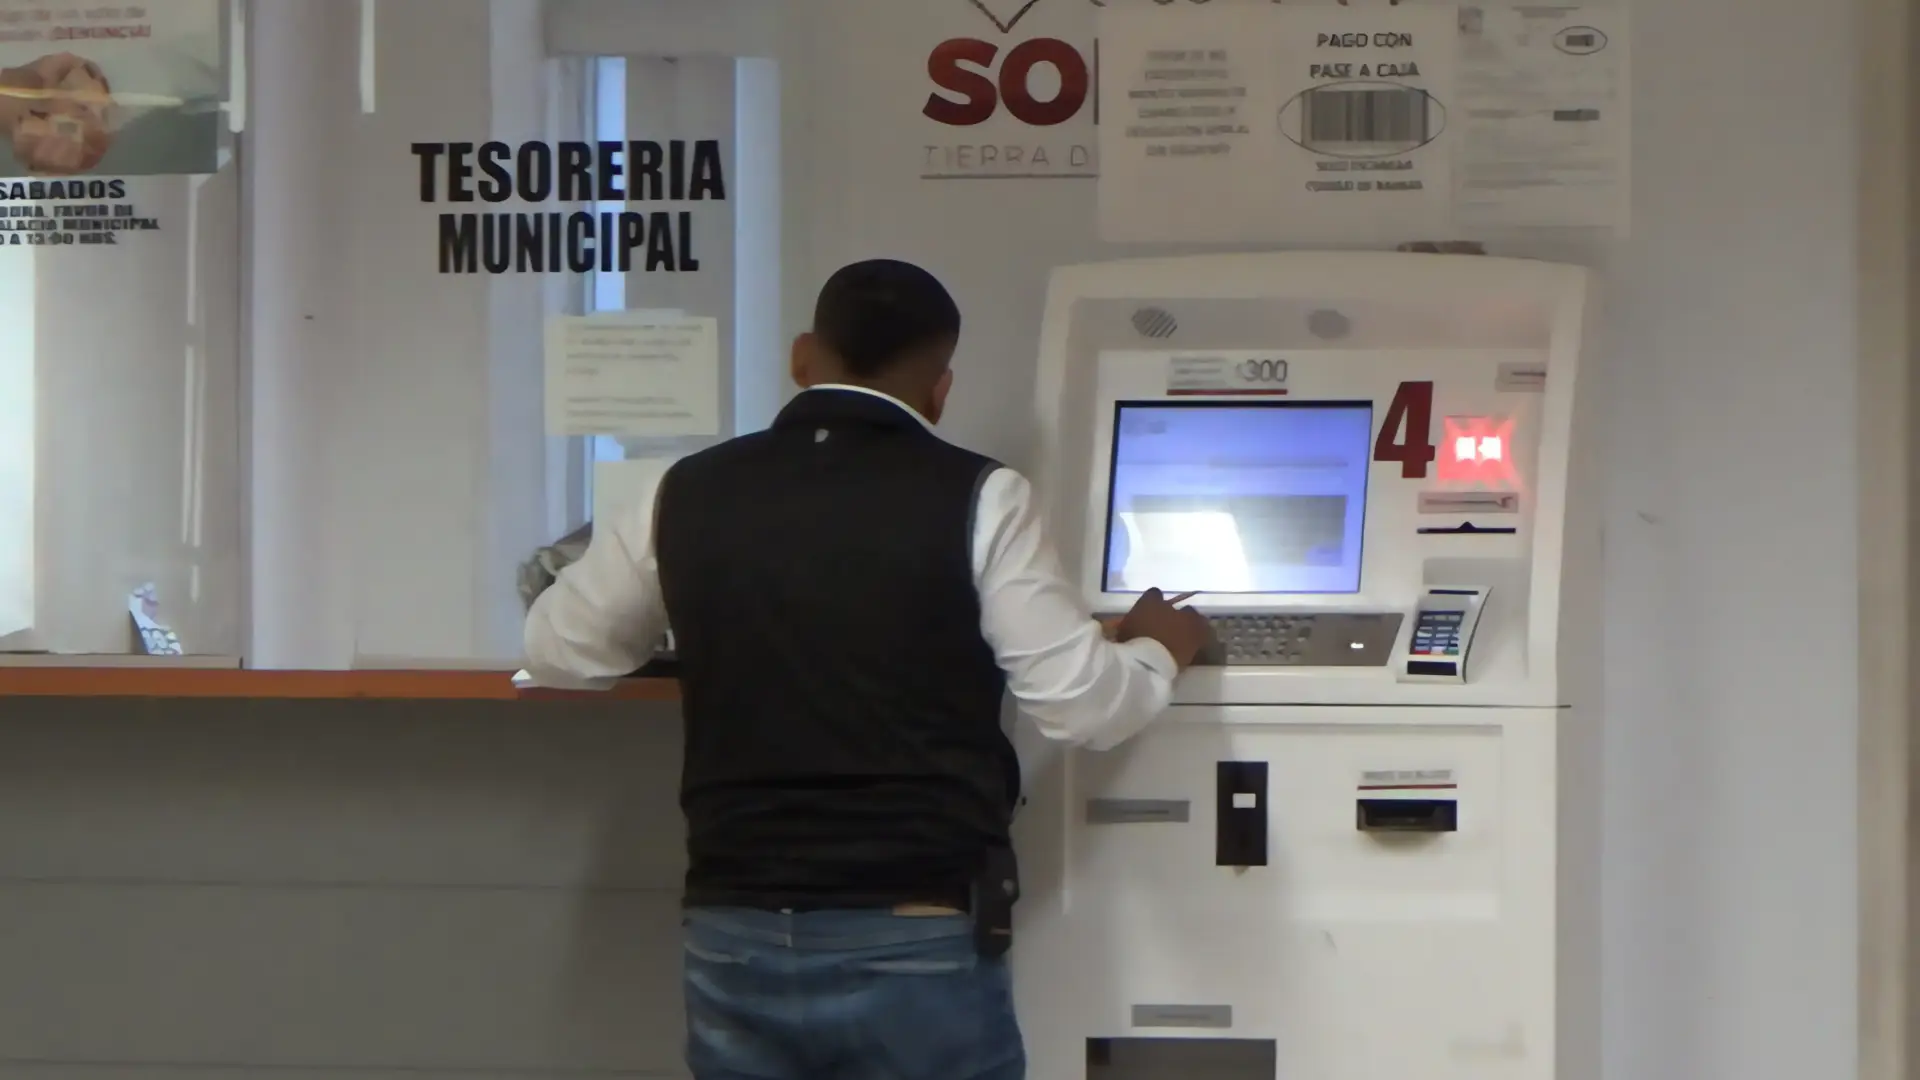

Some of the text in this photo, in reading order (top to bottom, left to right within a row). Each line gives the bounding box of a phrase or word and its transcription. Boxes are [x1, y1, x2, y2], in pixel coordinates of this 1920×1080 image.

[1316, 32, 1412, 47] PAGO CON
[1360, 64, 1370, 77] A
[922, 37, 1099, 126] SO
[411, 139, 726, 202] TESORERIA
[923, 145, 1050, 169] TIERRA
[439, 211, 699, 273] MUNICIPAL
[1373, 381, 1435, 478] 4
